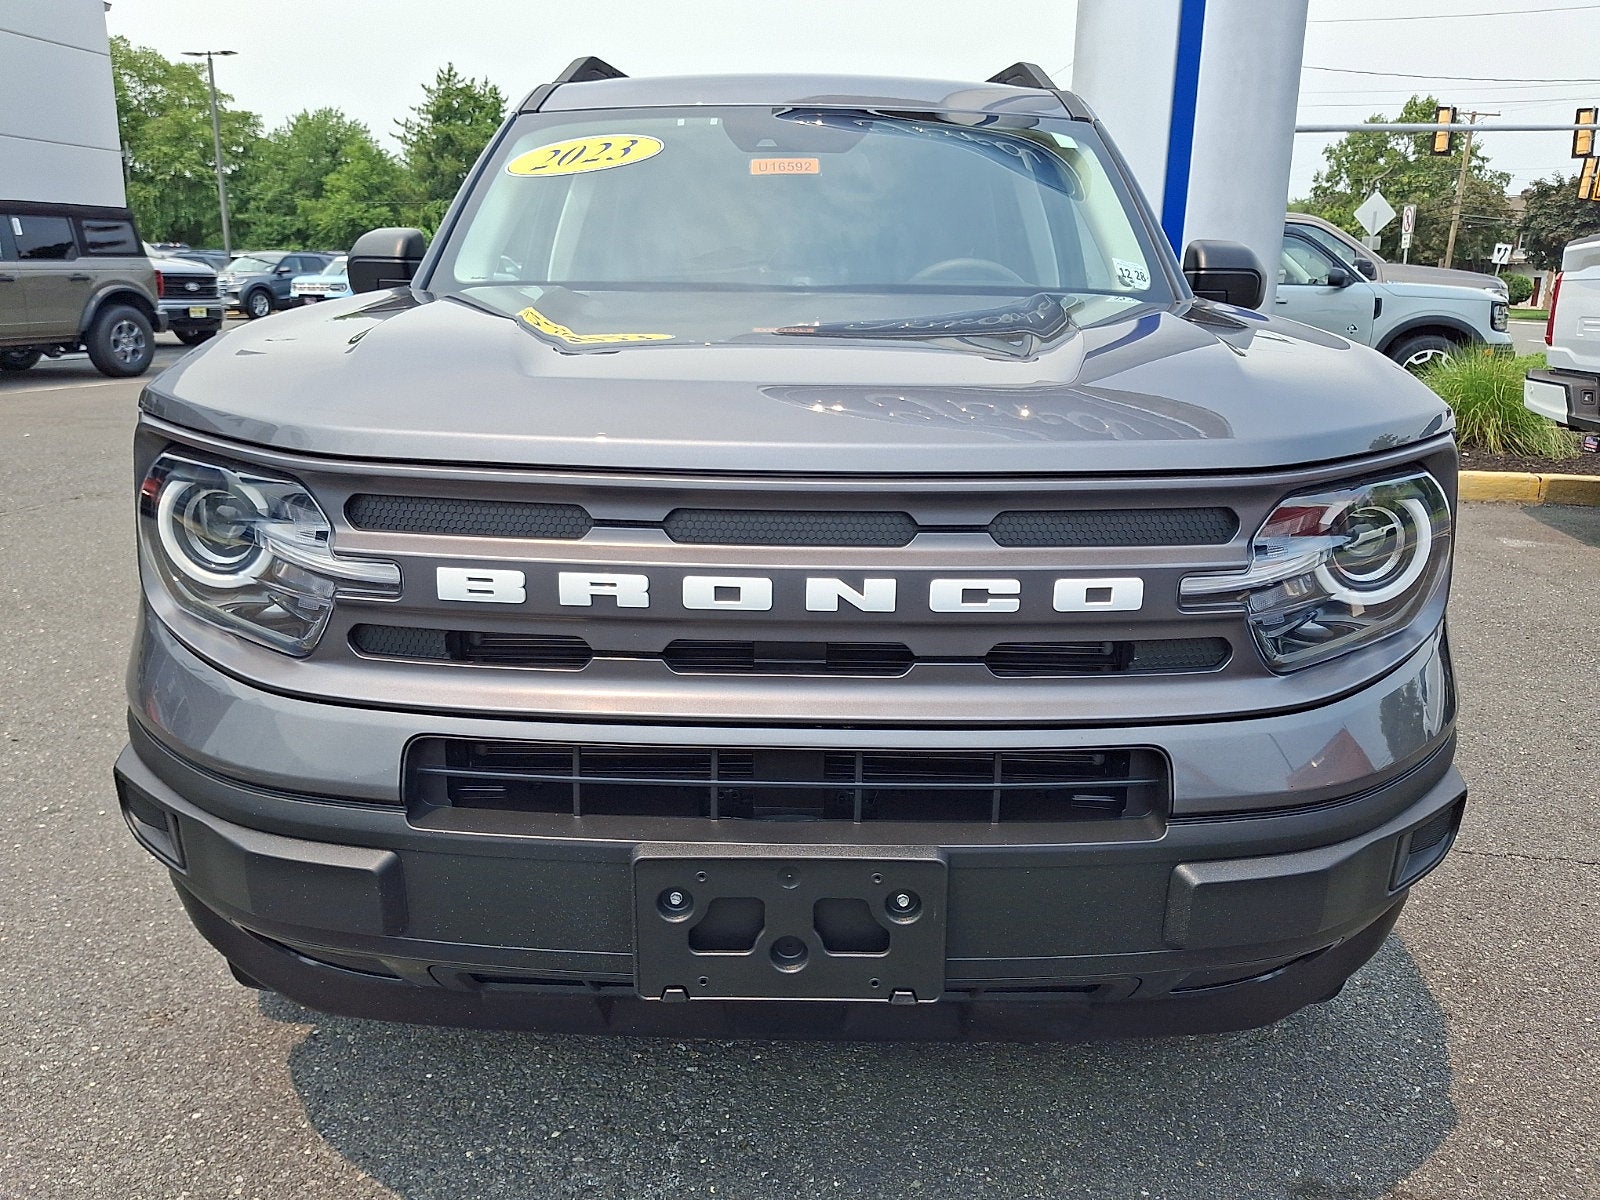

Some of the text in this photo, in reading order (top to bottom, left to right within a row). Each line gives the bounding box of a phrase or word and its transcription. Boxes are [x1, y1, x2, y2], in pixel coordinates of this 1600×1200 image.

[531, 139, 638, 171] 2023
[758, 161, 812, 172] U16592
[1119, 267, 1147, 282] 12 28
[437, 567, 1144, 612] BRONCO
